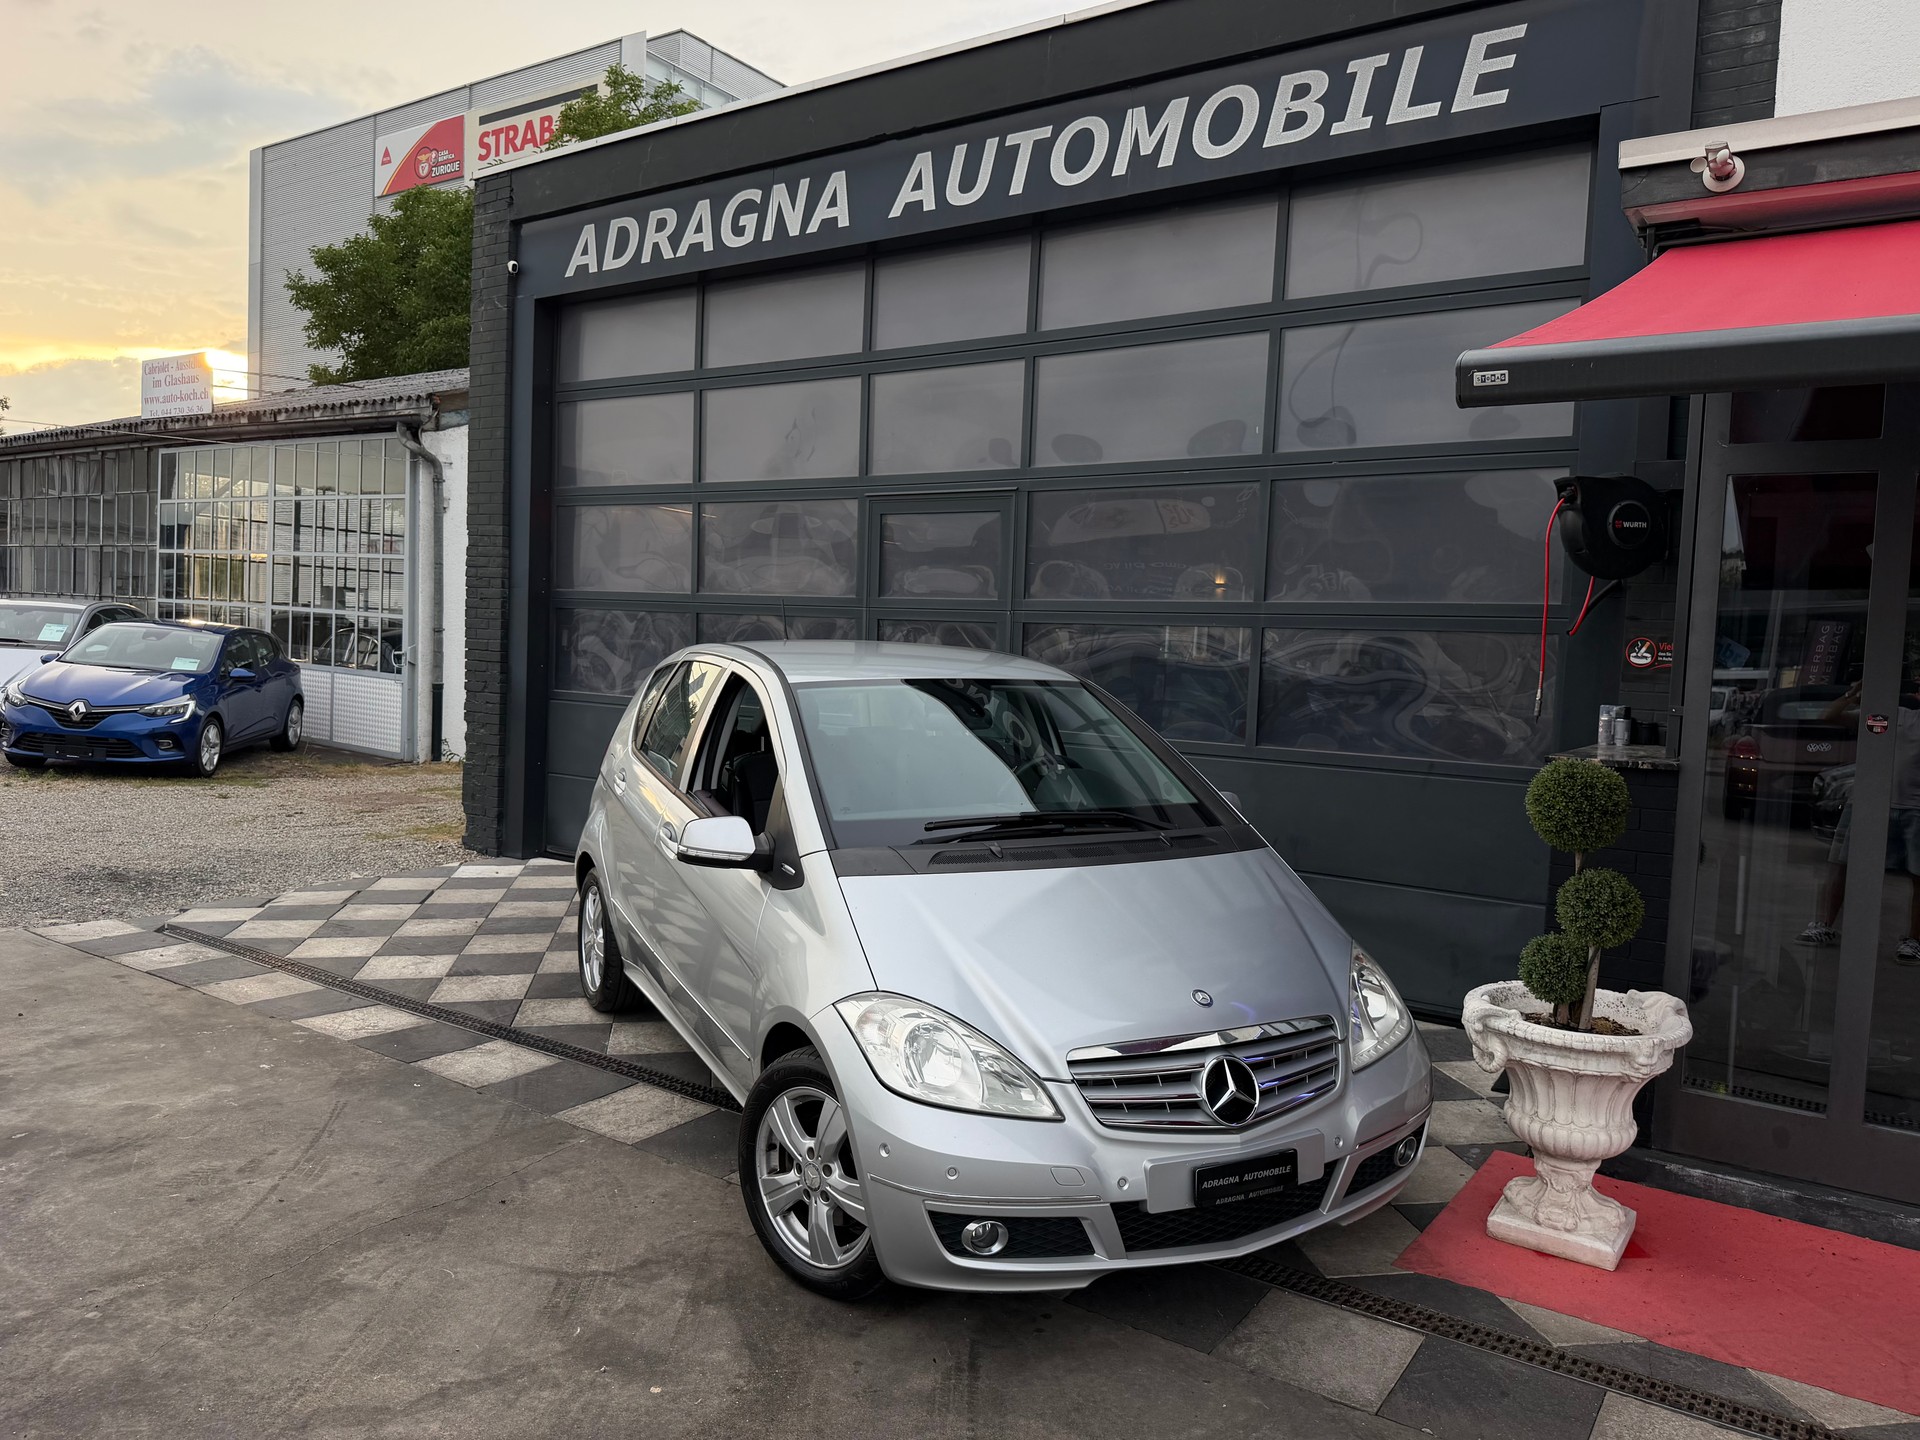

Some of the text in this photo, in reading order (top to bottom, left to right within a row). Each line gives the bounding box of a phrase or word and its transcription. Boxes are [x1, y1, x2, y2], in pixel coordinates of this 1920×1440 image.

[477, 114, 555, 162] STRAB
[565, 22, 1528, 278] ADRAGNA AUTOMOBILE
[431, 161, 460, 177] ZURIQUE
[144, 361, 170, 376] Cabriolet
[152, 372, 200, 388] im Glashaus
[143, 387, 209, 405] www.auto-koch.ch
[150, 409, 160, 417] Tel.
[160, 408, 172, 416] 044
[173, 407, 185, 415] 730
[1659, 643, 1674, 651] Viel
[1807, 625, 1830, 685] MERBAG
[1201, 1164, 1292, 1189] ADRAGNA AUTOMOBILE
[1215, 1184, 1284, 1205] ADRAGNA AUTOMOBILE
